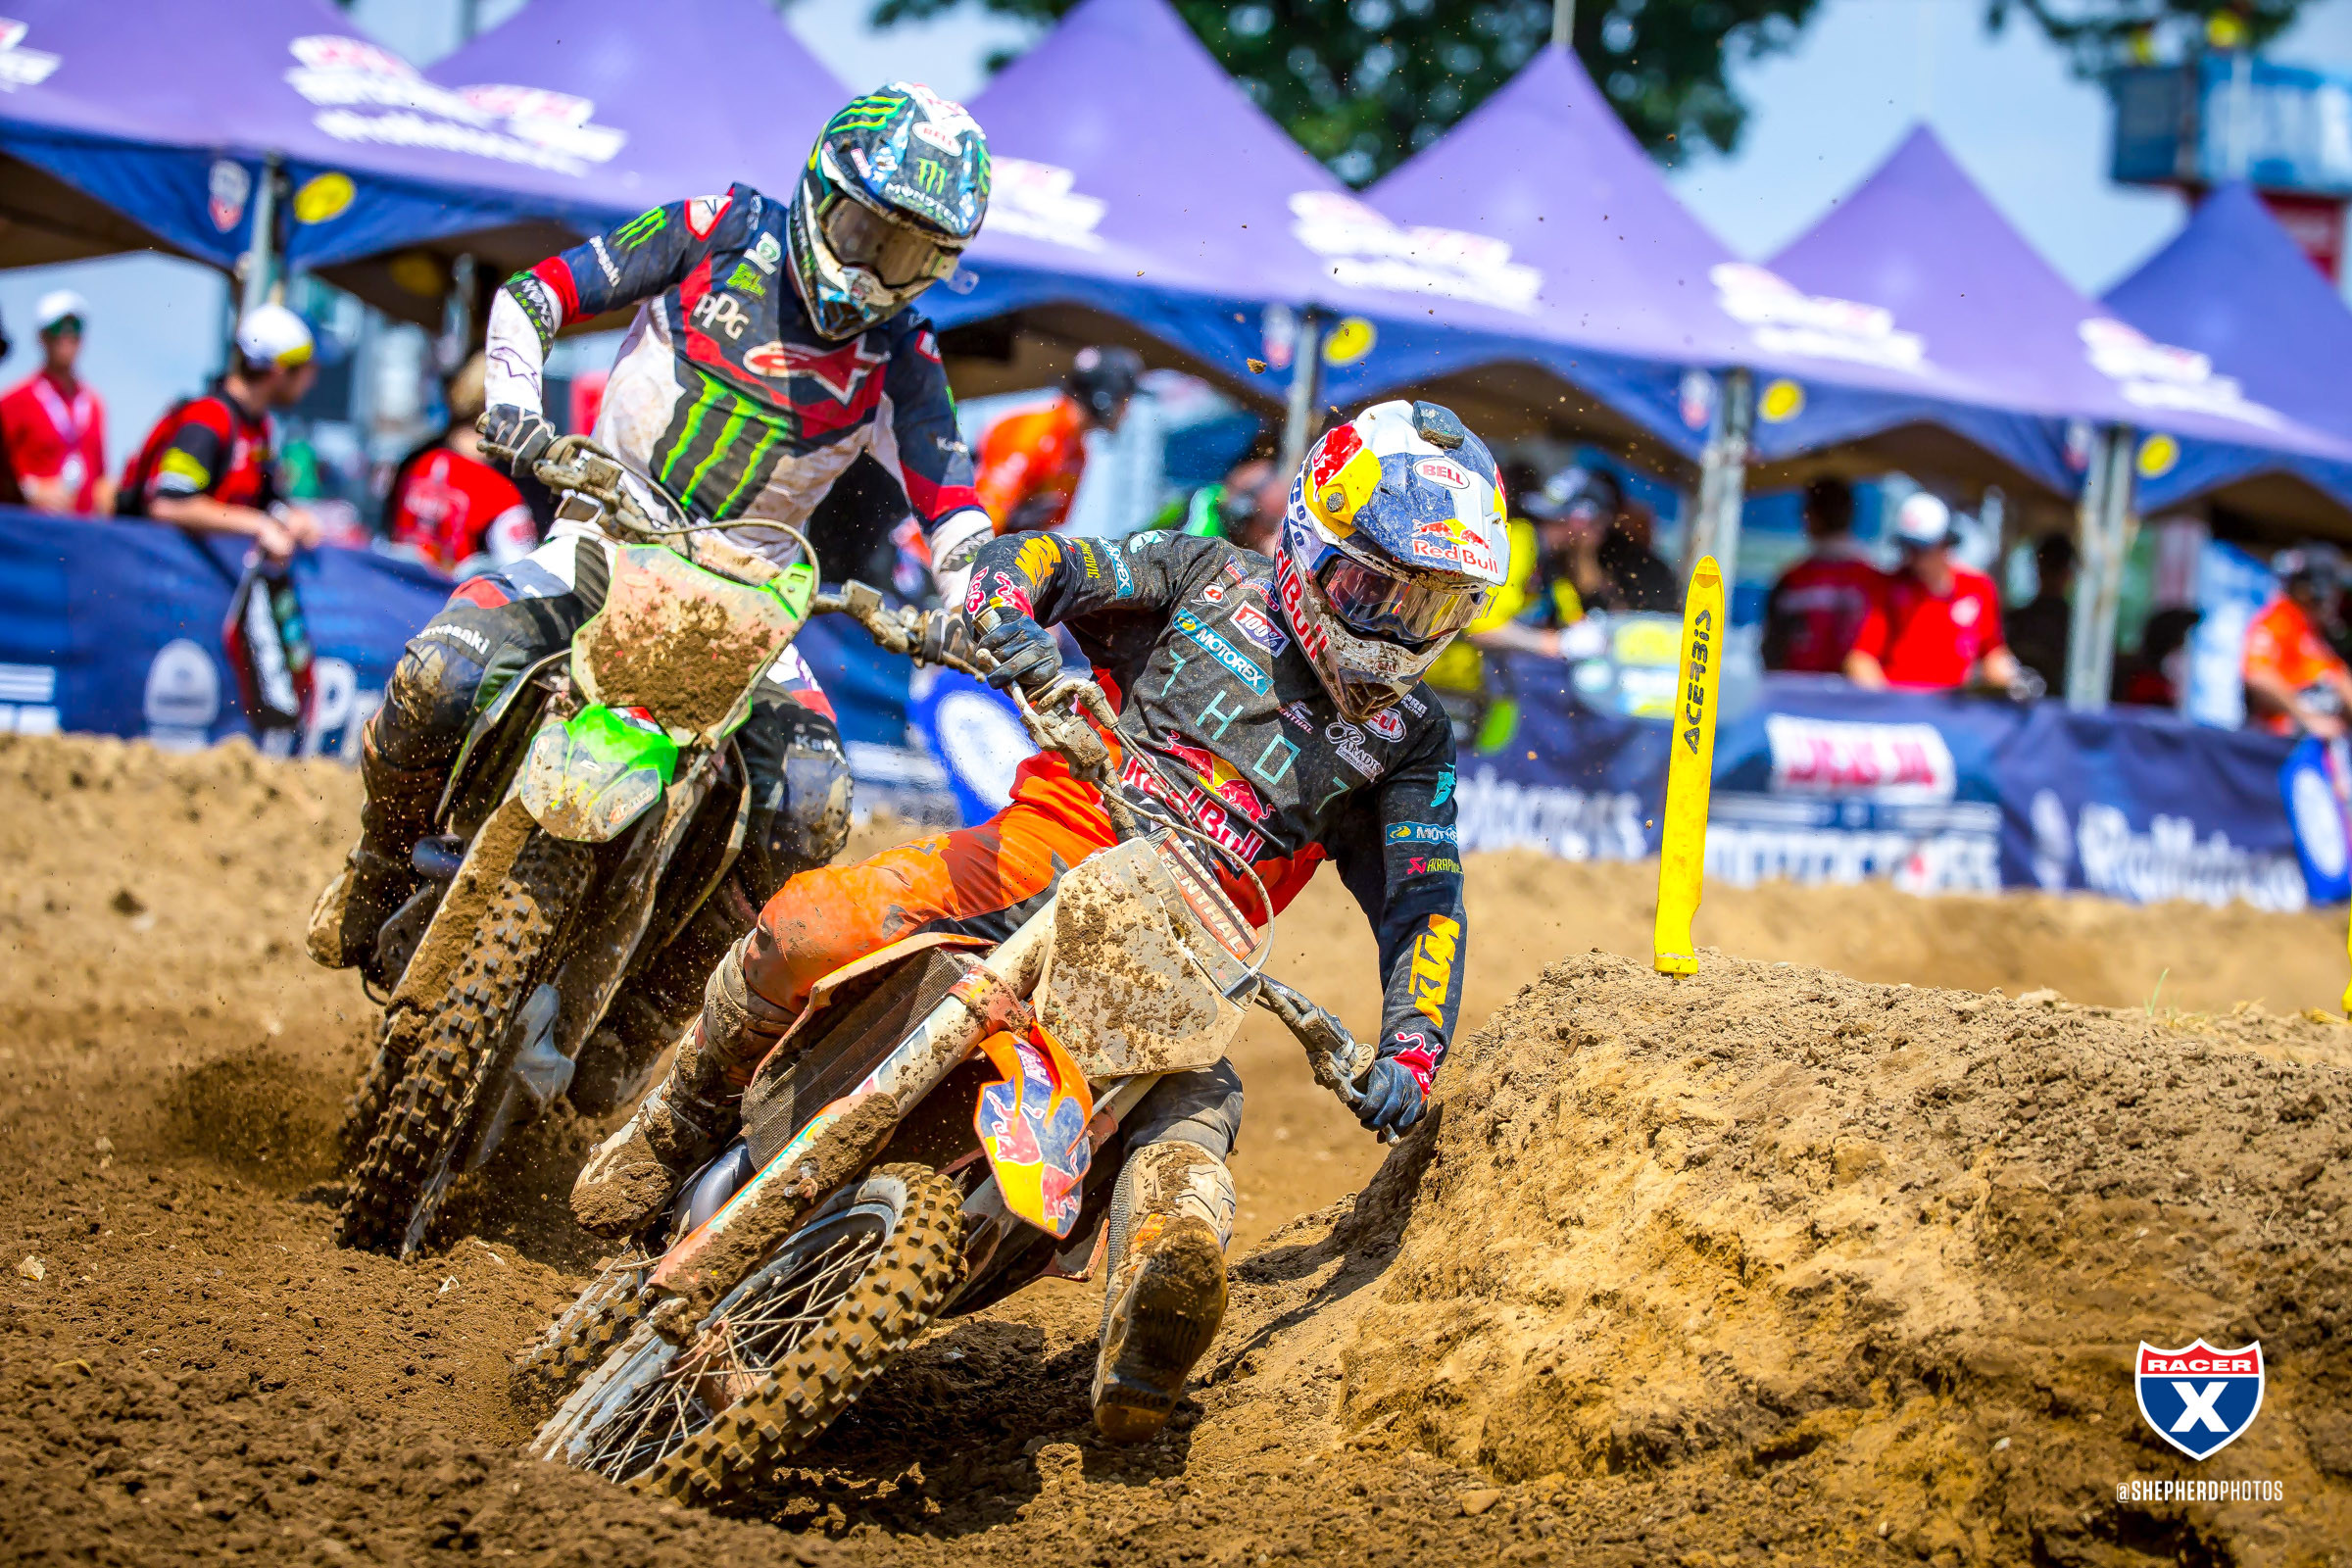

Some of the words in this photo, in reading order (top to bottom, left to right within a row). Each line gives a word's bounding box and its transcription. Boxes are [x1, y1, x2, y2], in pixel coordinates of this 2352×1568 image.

[1423, 464, 1464, 486] BELL
[1414, 540, 1460, 562] Red
[1462, 549, 1498, 574] Bull
[1196, 627, 1264, 688] MOTOREX
[1241, 611, 1279, 649] 100%
[1683, 609, 1711, 756] ACERBIS
[1160, 849, 1245, 954] RENTHAL
[1408, 913, 1460, 1029] KTM
